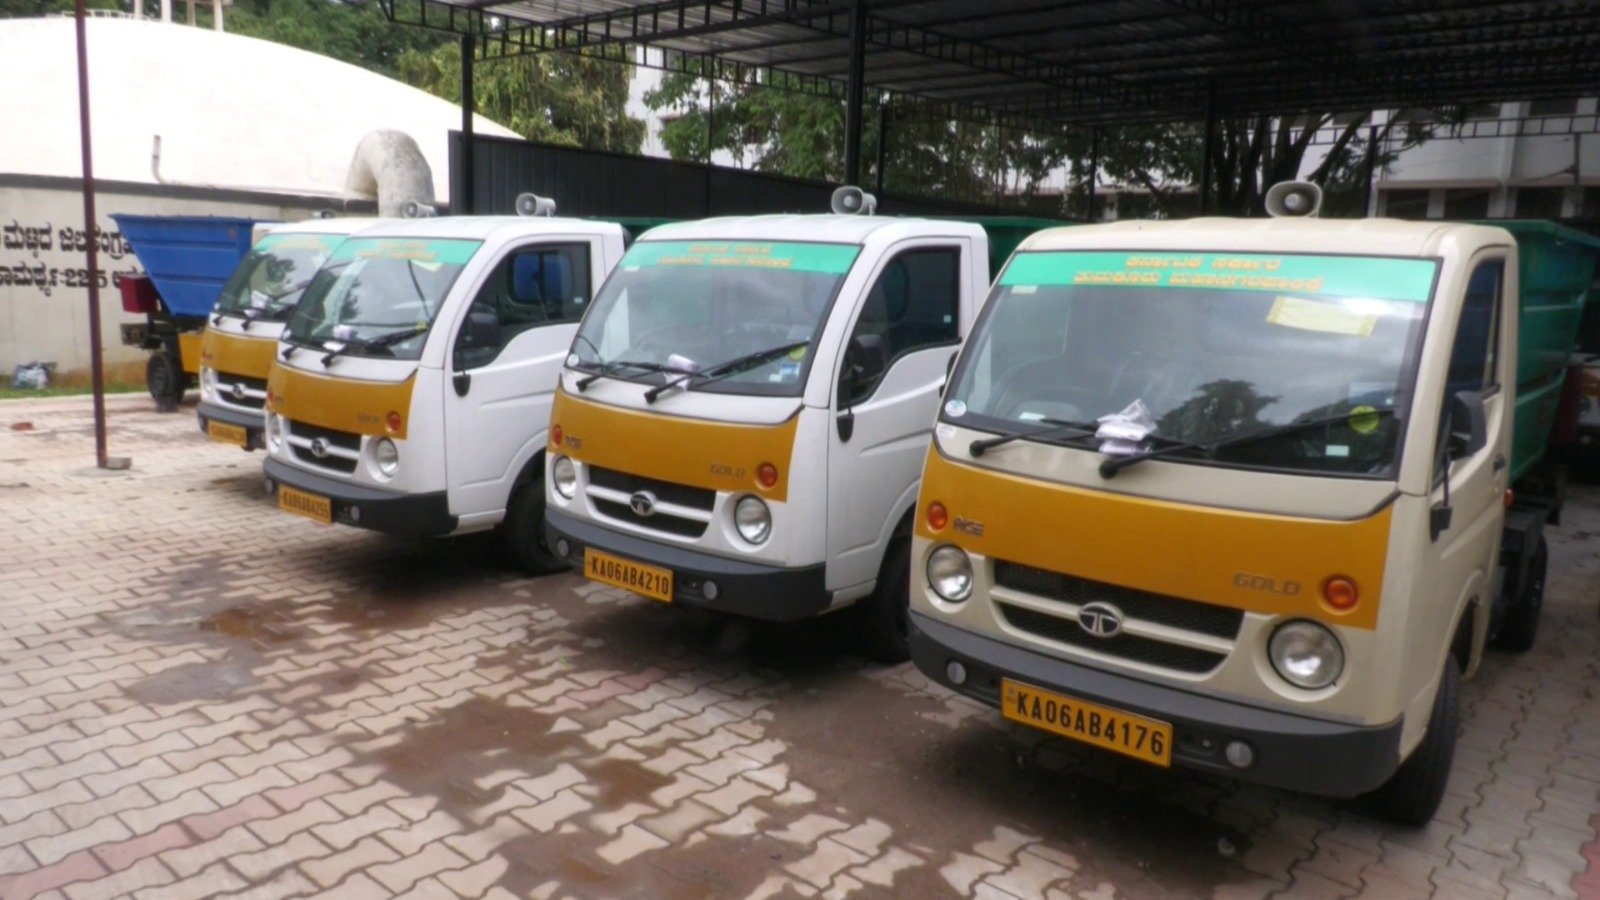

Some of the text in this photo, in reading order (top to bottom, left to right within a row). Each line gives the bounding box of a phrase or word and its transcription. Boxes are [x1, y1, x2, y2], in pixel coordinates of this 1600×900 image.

[591, 556, 669, 595] KA06AB4210
[1233, 572, 1300, 596] GOLD
[1017, 691, 1164, 756] KA06AB4176
